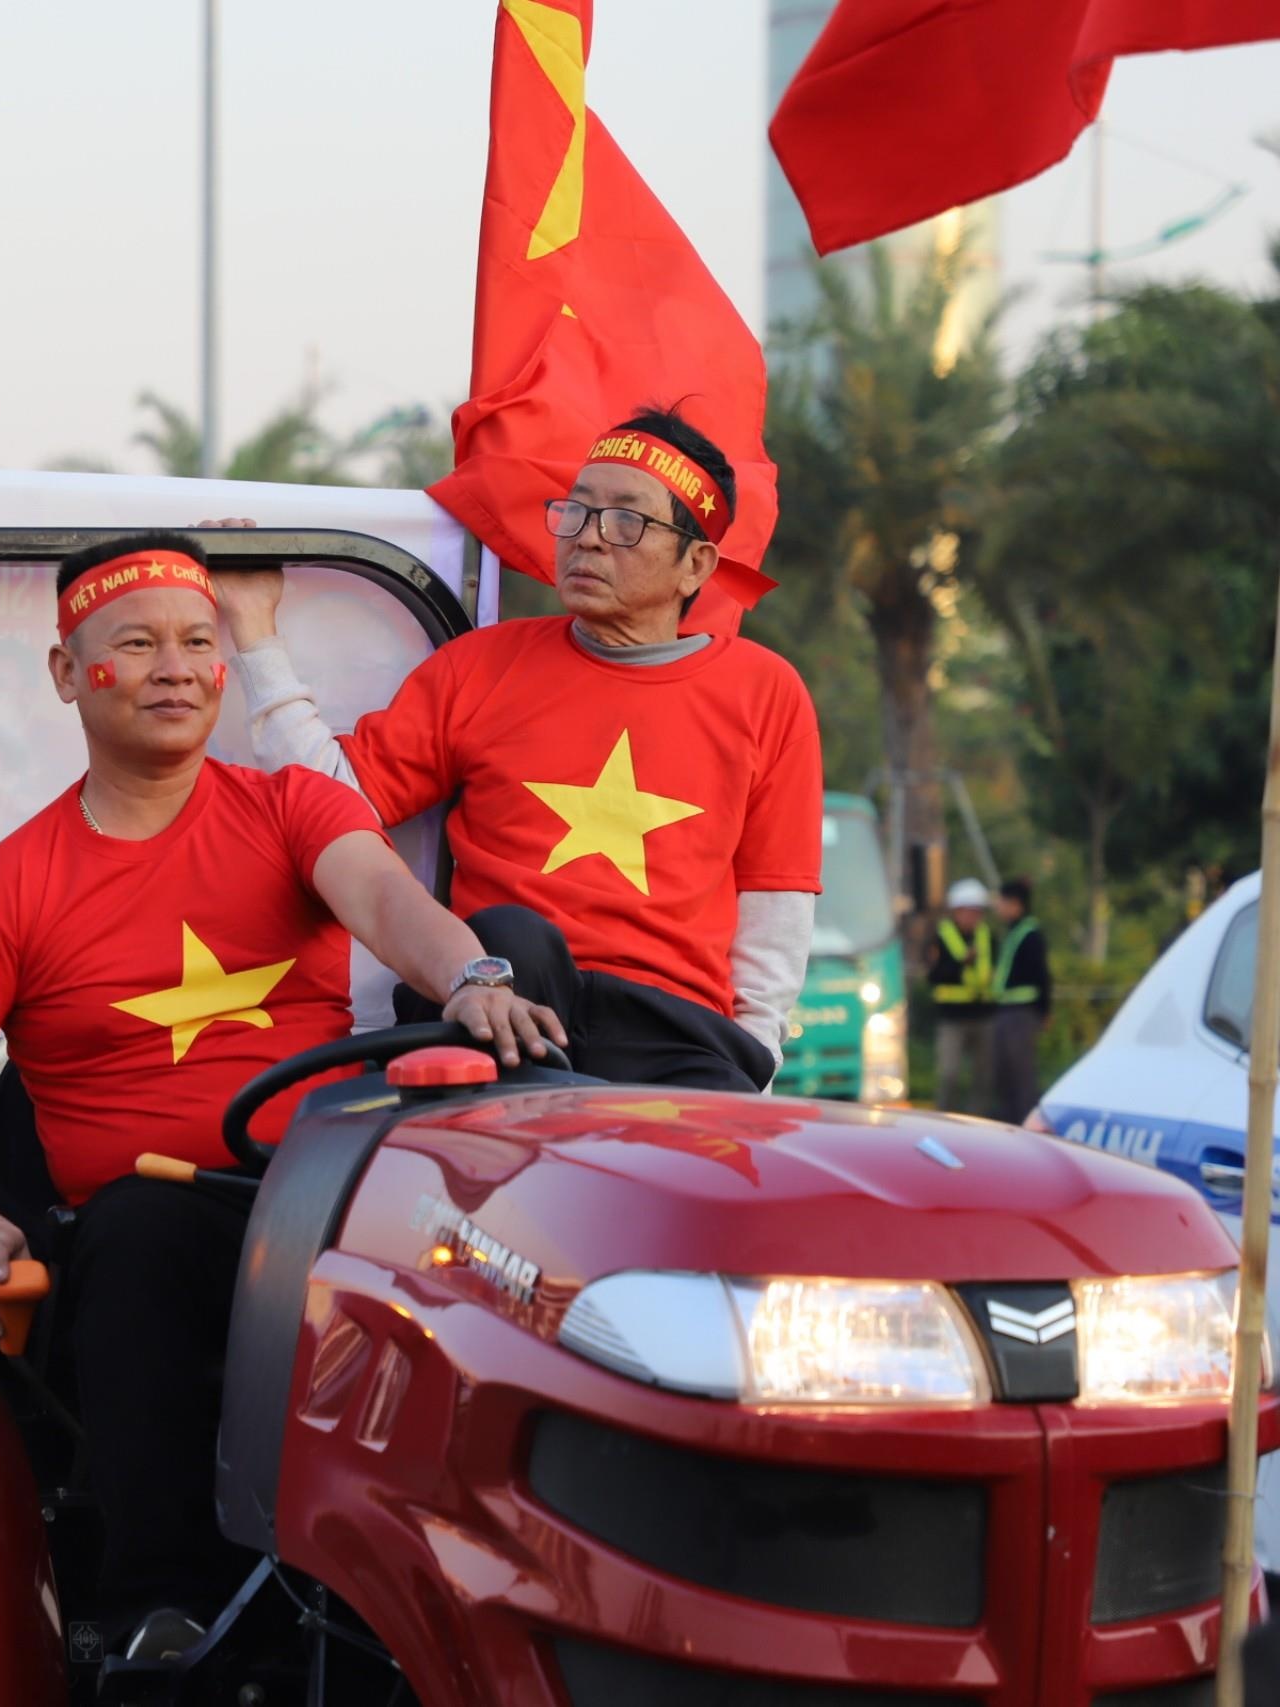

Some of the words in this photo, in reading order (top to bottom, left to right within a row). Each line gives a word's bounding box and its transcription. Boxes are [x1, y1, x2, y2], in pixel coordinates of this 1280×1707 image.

[591, 433, 647, 461] CHIẾN
[646, 446, 702, 500] THẮNG
[69, 582, 97, 614] VIỆT
[101, 566, 140, 594] NAM
